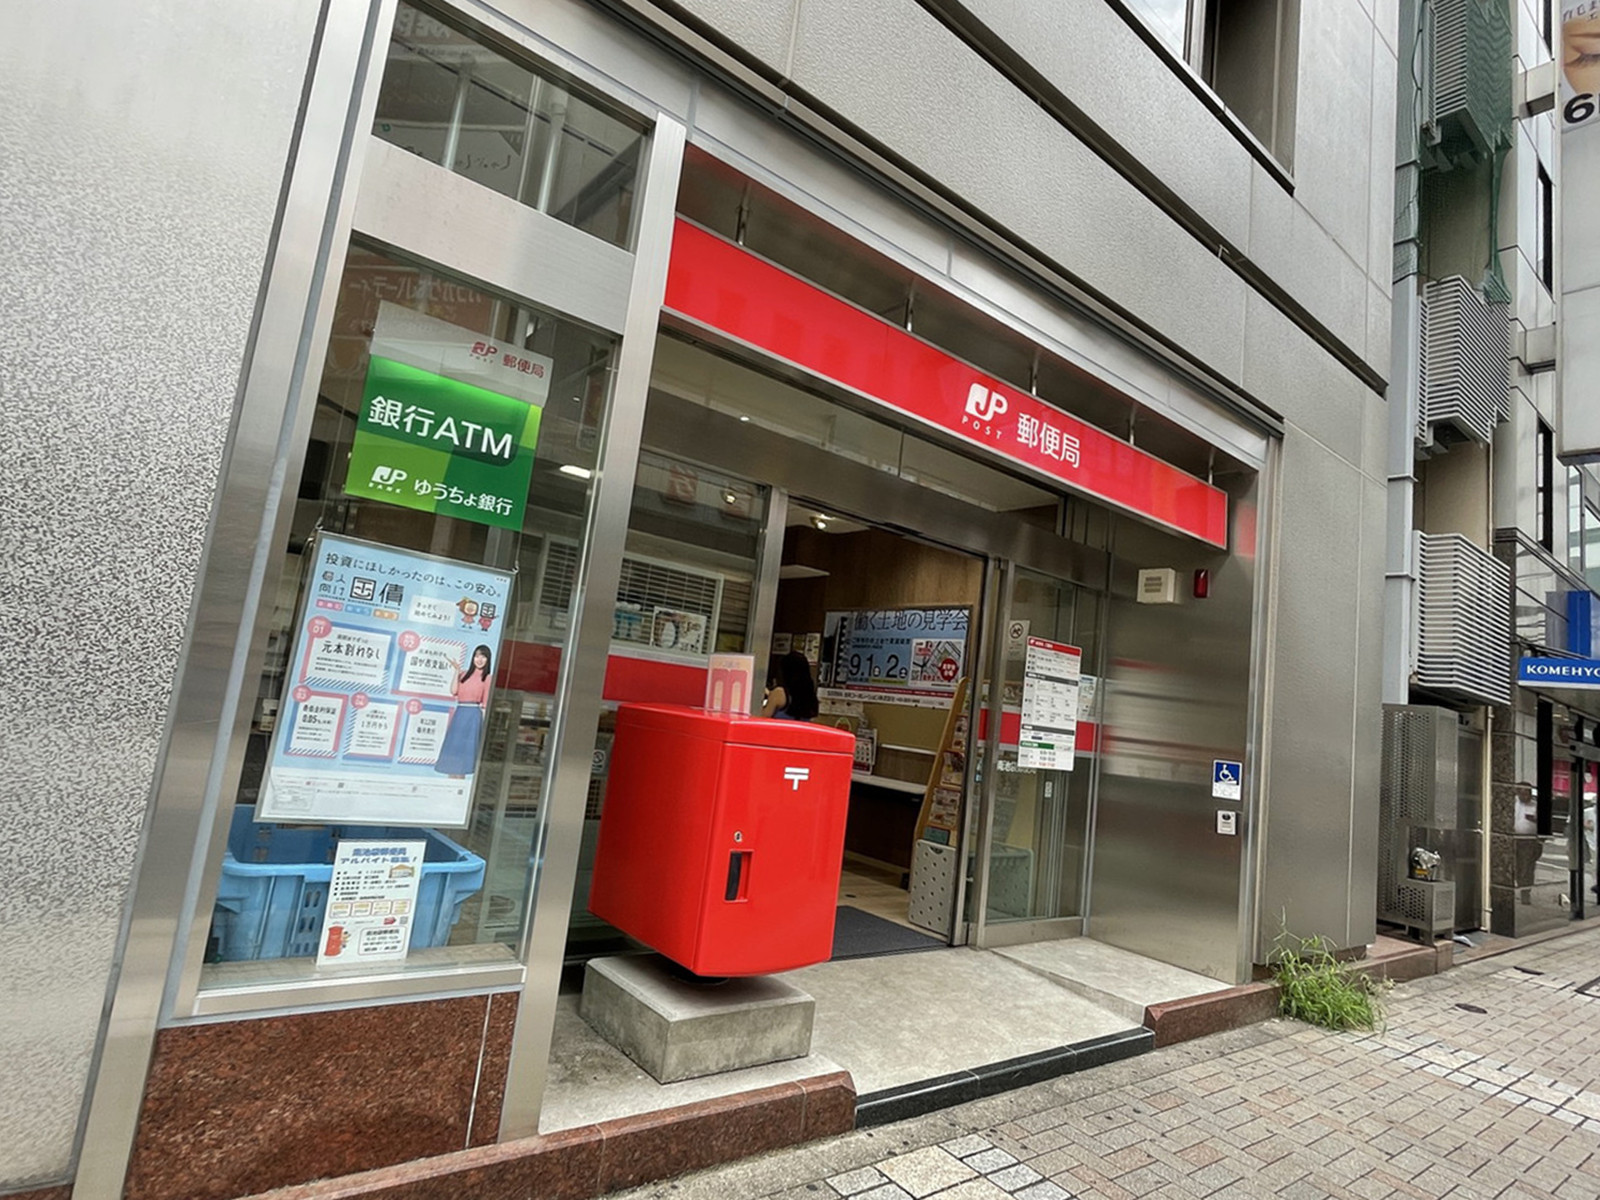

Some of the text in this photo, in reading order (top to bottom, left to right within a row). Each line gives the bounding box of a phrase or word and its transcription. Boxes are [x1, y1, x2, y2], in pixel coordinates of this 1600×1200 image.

[502, 353, 545, 379] 郵便局
[367, 395, 513, 459] 銀行ATM
[961, 415, 1002, 440] POST
[1016, 412, 1081, 469] 郵便局
[413, 479, 513, 516] ゆうちょ銀行
[325, 552, 501, 599] 投資にほしかったのは、この安心。
[321, 640, 380, 660] 元本割れなし
